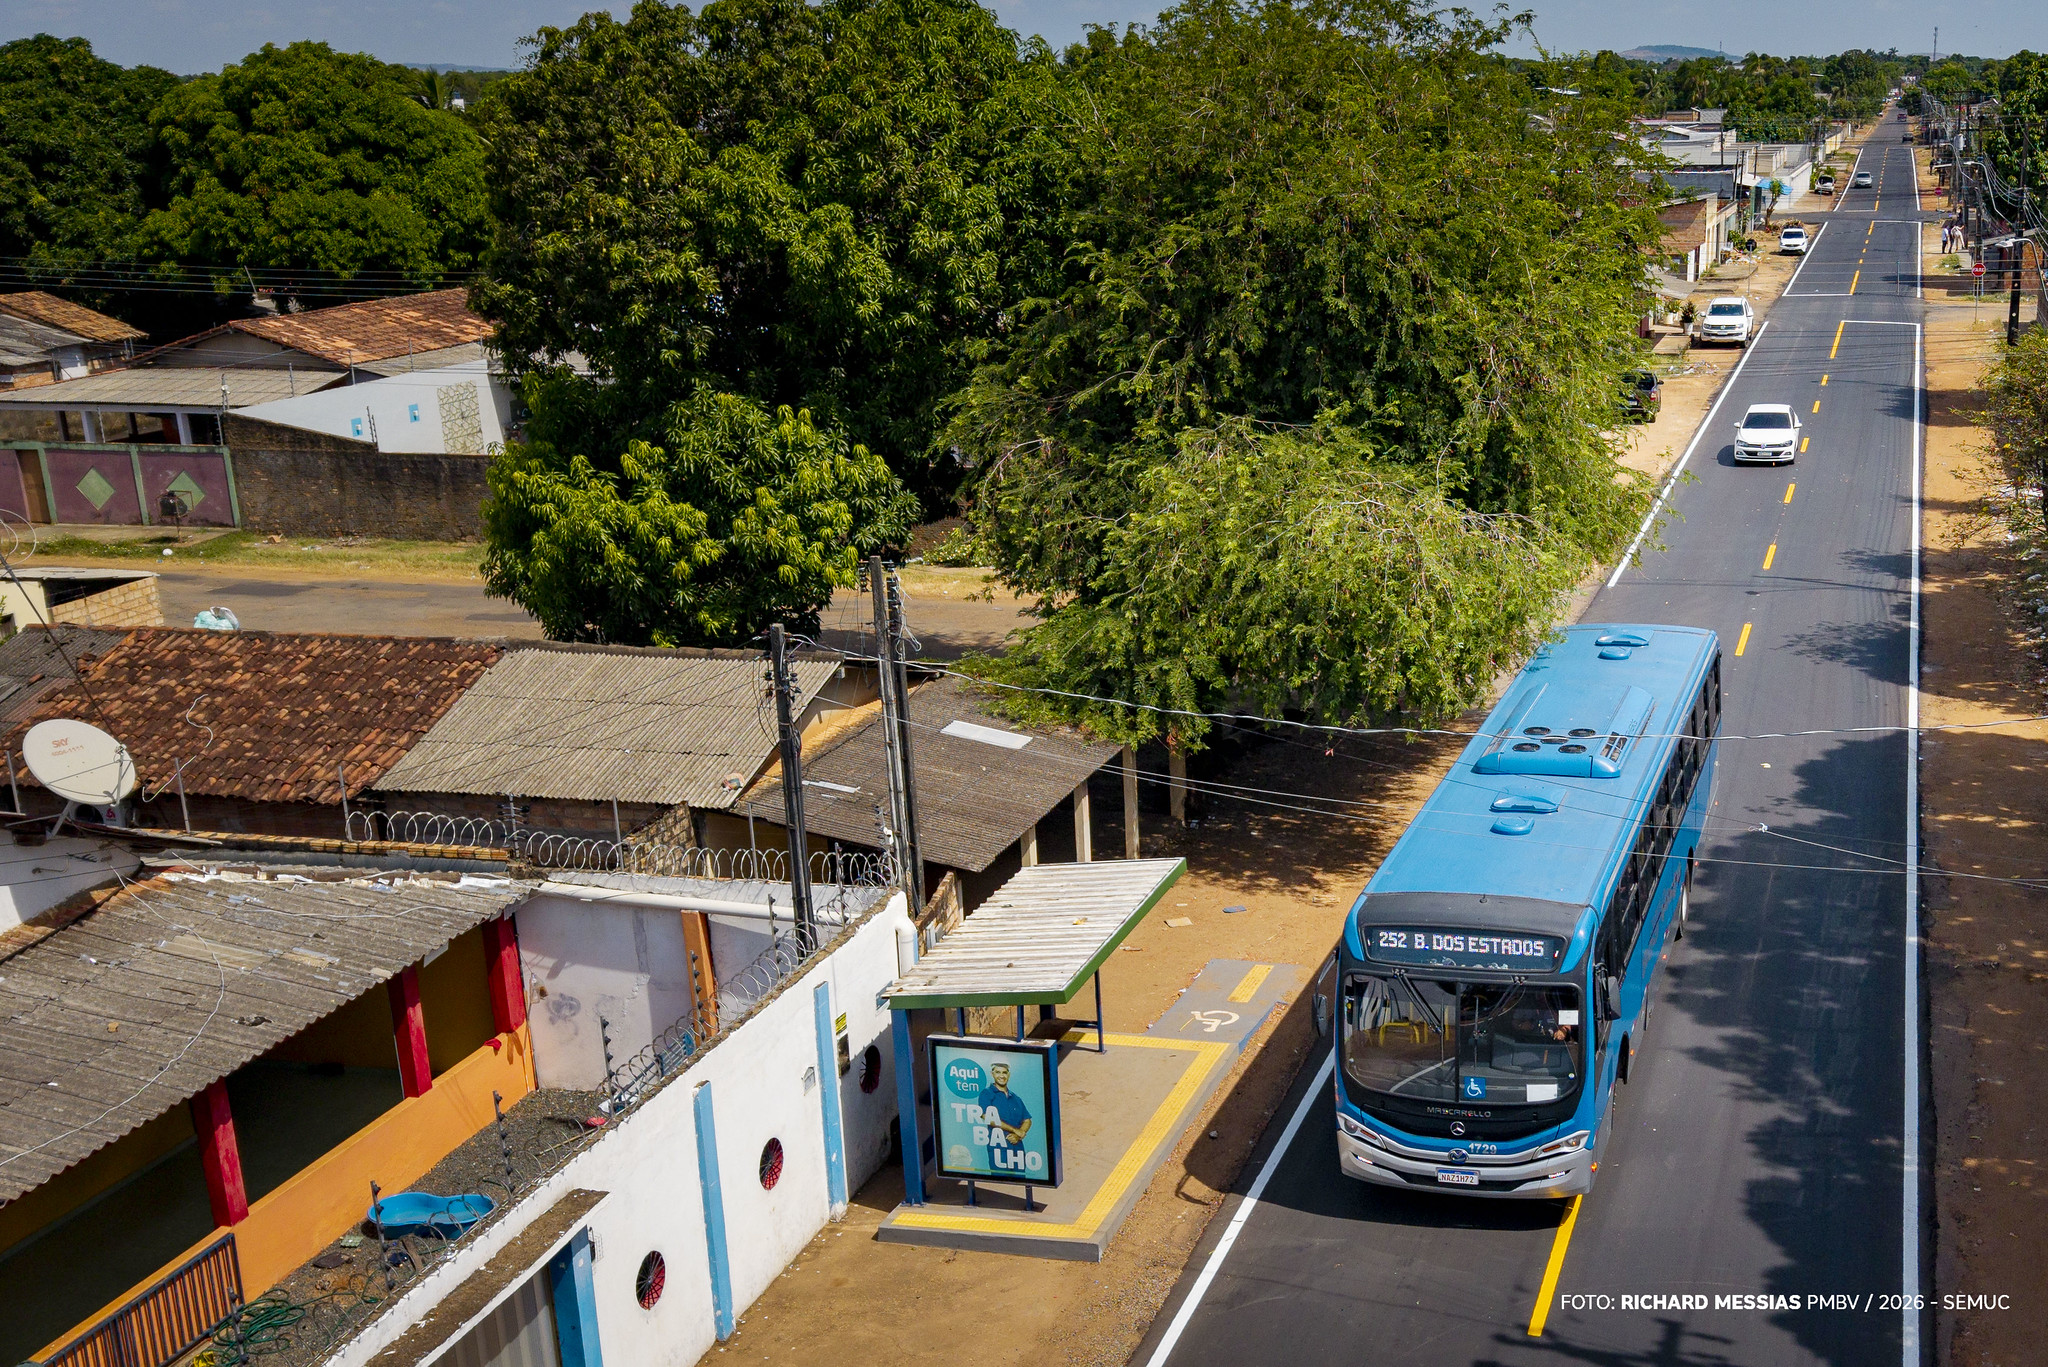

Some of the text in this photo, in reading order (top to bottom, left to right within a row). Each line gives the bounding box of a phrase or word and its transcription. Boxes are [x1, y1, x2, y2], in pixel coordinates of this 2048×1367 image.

[52, 737, 69, 749] SKY
[1379, 931, 1545, 957] 252 B. DOS ESTADOS
[949, 1065, 979, 1081] Aqui
[956, 1080, 980, 1092] tem
[950, 1102, 1002, 1126] TRA
[1426, 1106, 1492, 1118] MASCARELLO
[972, 1126, 1008, 1148] BA
[1468, 1143, 1497, 1155] 1729
[993, 1148, 1043, 1172] LHO
